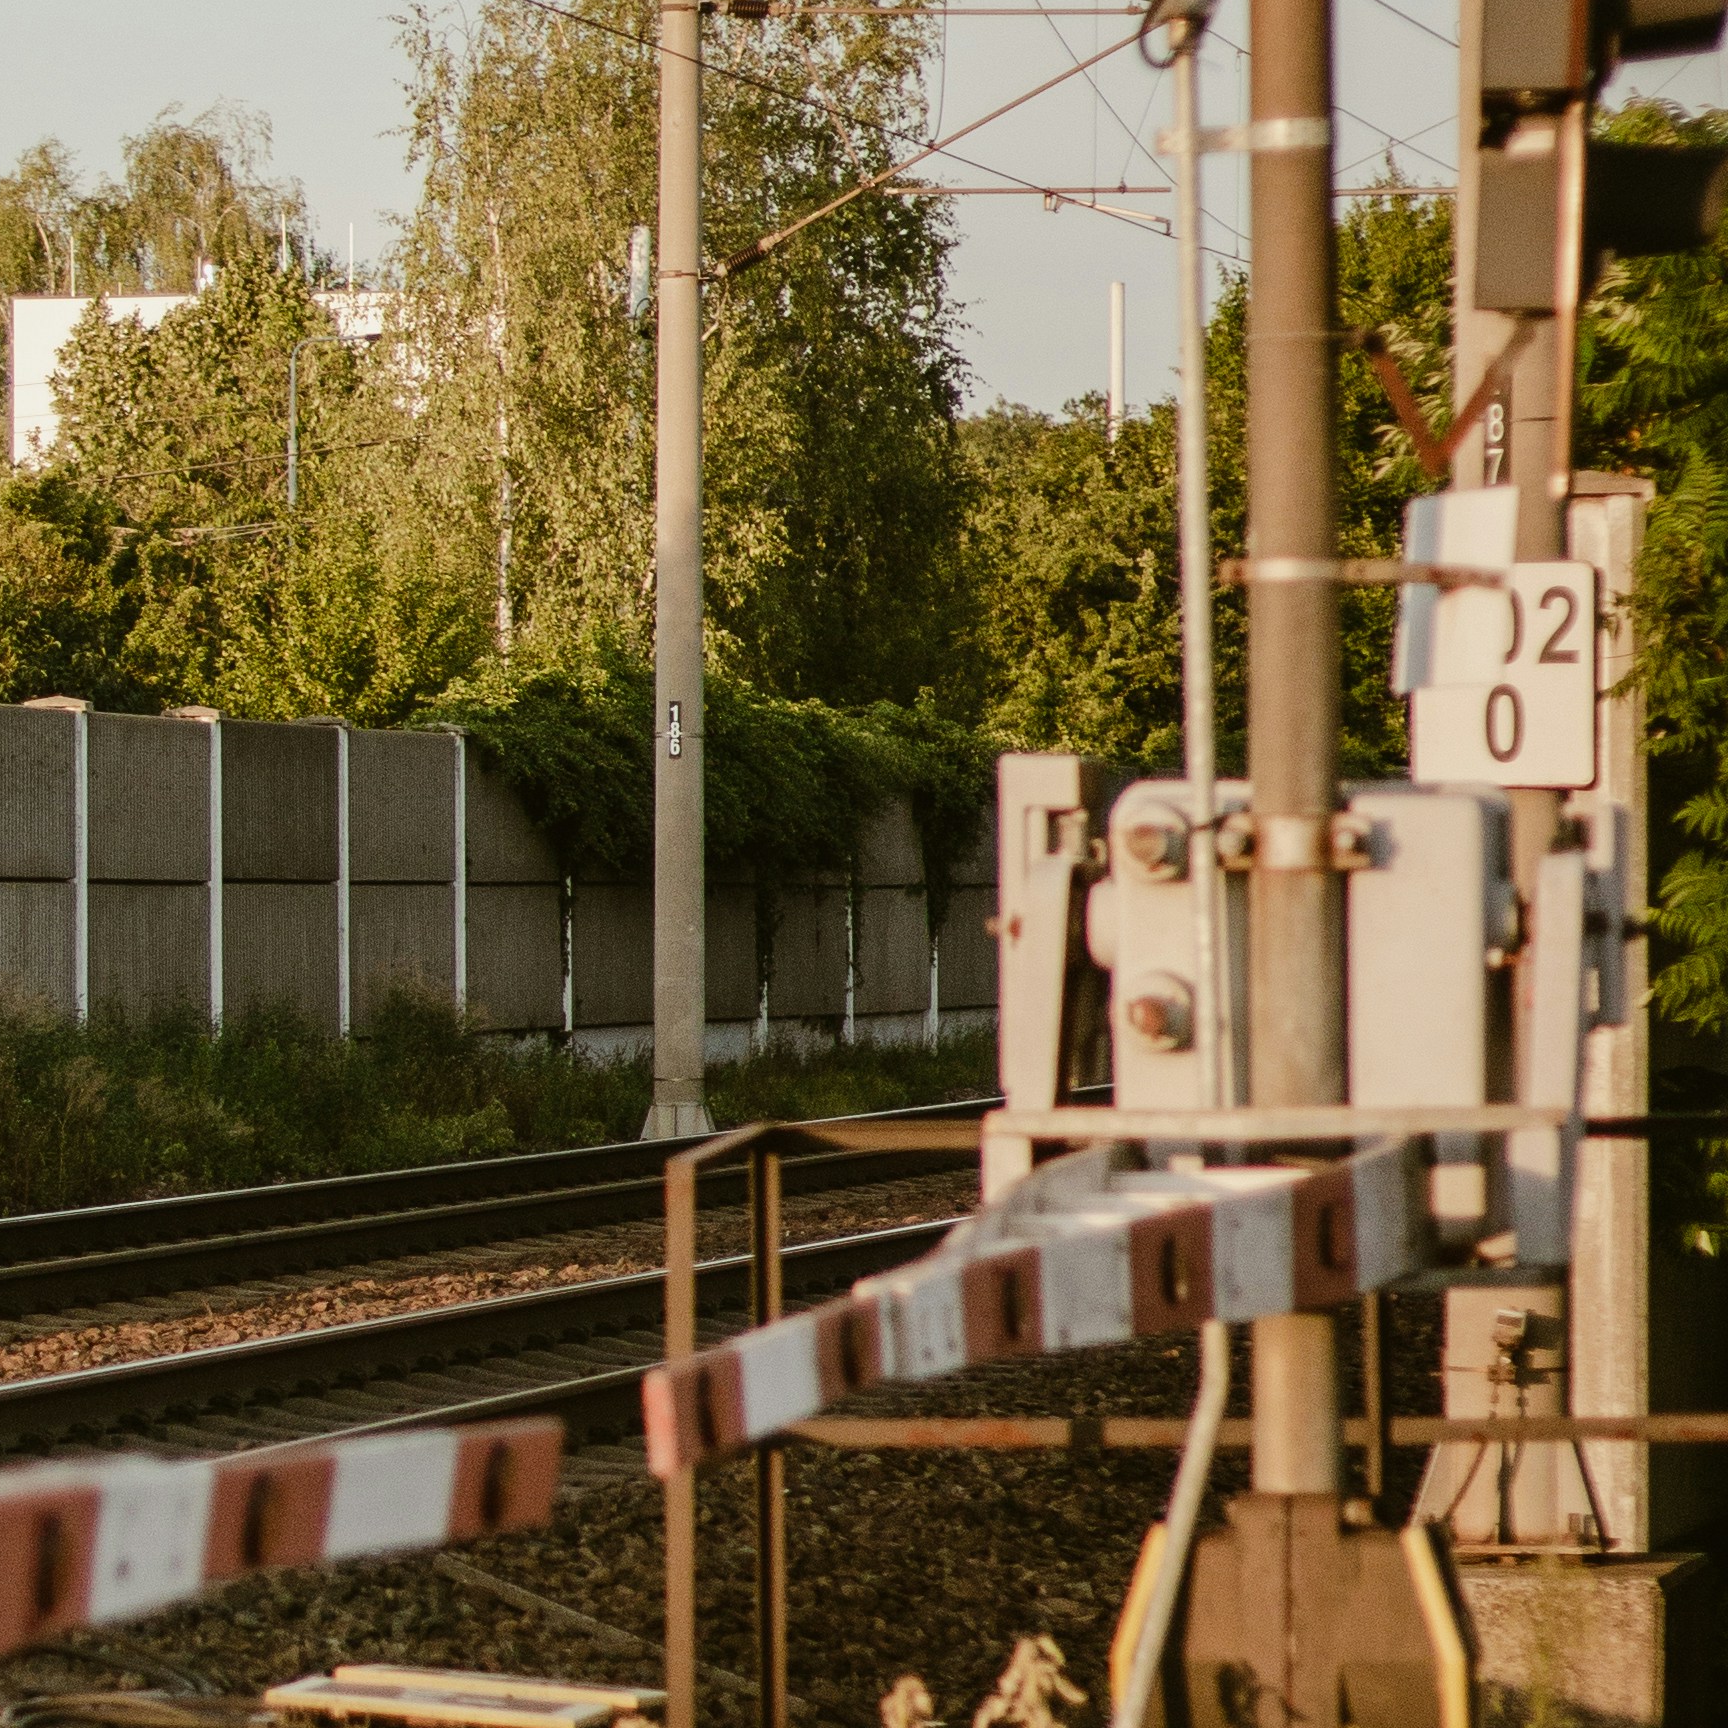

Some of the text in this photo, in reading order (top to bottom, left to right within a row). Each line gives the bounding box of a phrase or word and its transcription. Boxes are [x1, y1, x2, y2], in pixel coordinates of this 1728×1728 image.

[1486, 388, 1504, 485] 87
[670, 704, 680, 755] 186
[1486, 683, 1525, 763] 0
